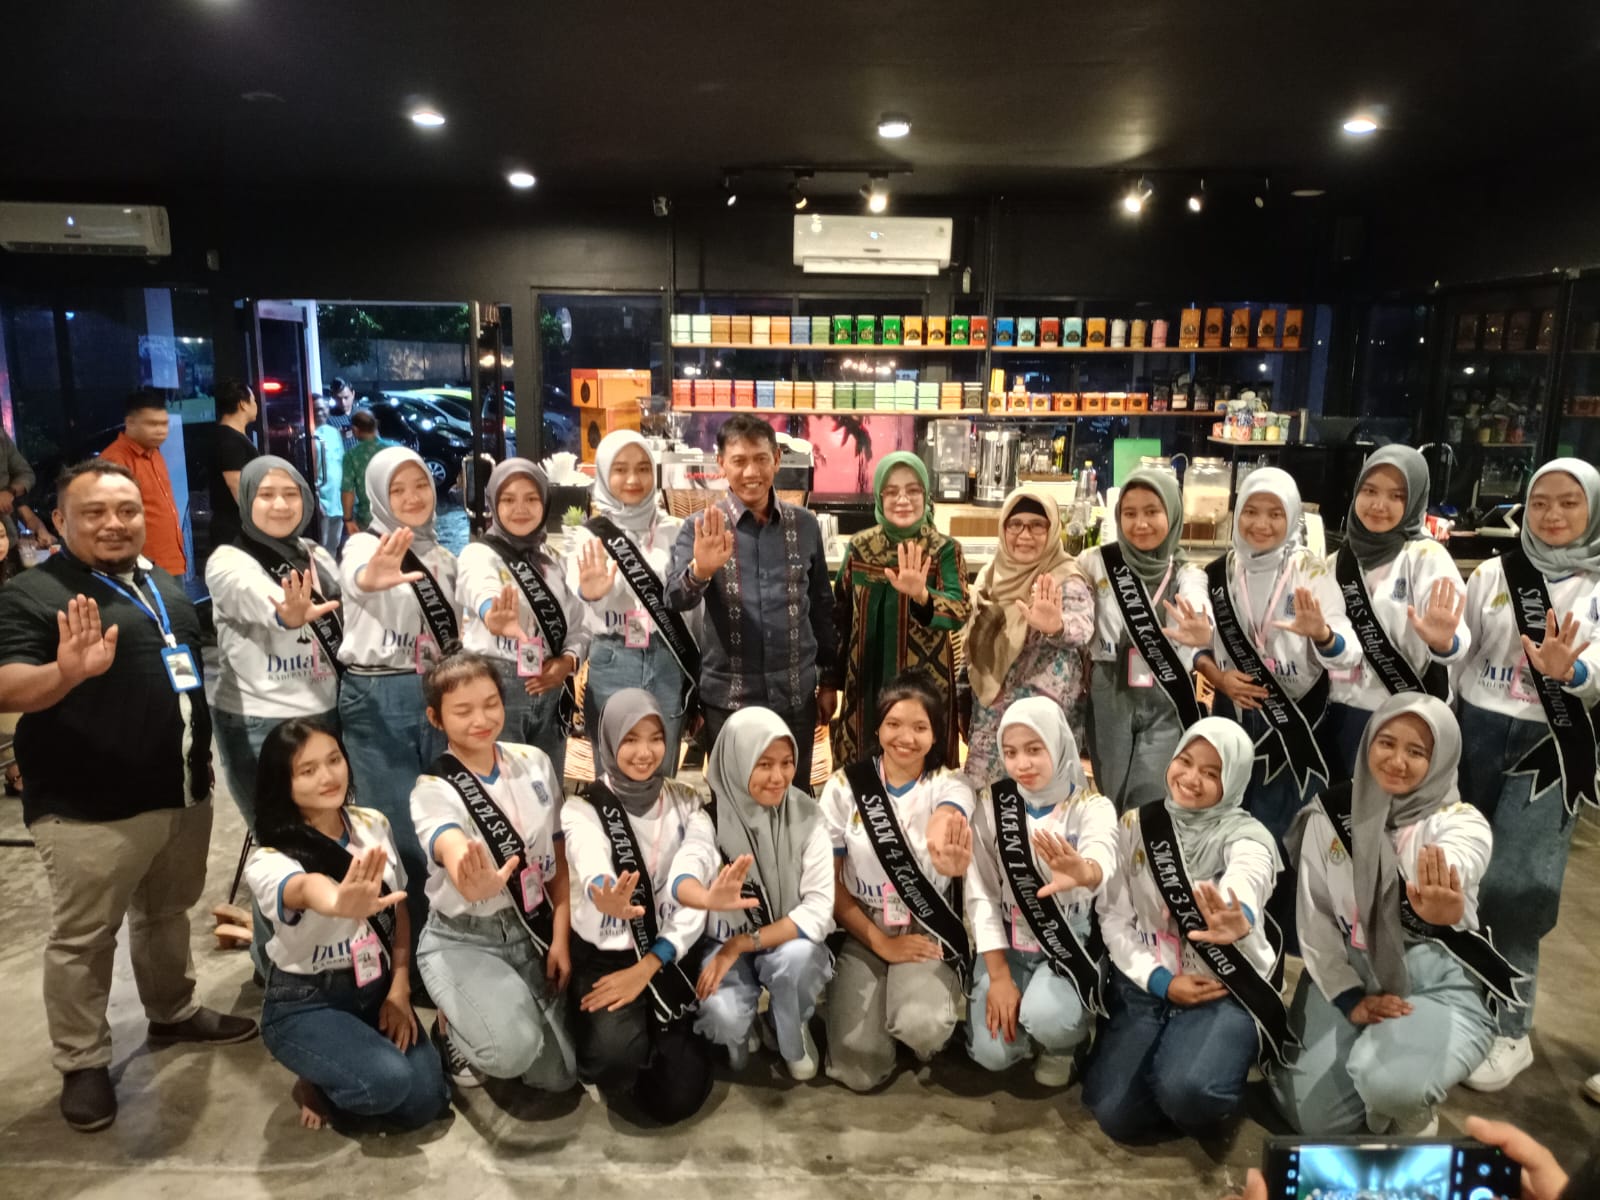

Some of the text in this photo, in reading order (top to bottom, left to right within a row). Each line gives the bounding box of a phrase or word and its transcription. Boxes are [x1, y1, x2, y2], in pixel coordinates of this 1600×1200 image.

[608, 537, 645, 576] SMKN
[632, 572, 648, 583] 1
[416, 573, 442, 607] MAN
[511, 562, 549, 603] SMAN
[540, 604, 556, 616] 2
[1342, 580, 1368, 618] MAS
[1113, 565, 1178, 683] SMKN 1 Ketapang
[267, 653, 314, 673] Duta
[1261, 684, 1289, 724] Slatan
[447, 771, 487, 806] SMAN
[486, 820, 508, 838] St
[603, 806, 637, 866] SMAN
[861, 795, 935, 918] SMAN 4 Ketapang
[999, 793, 1073, 960] SMAN 1 Muara Pawan
[1150, 841, 1182, 889] SMAN
[1170, 893, 1190, 905] 3
